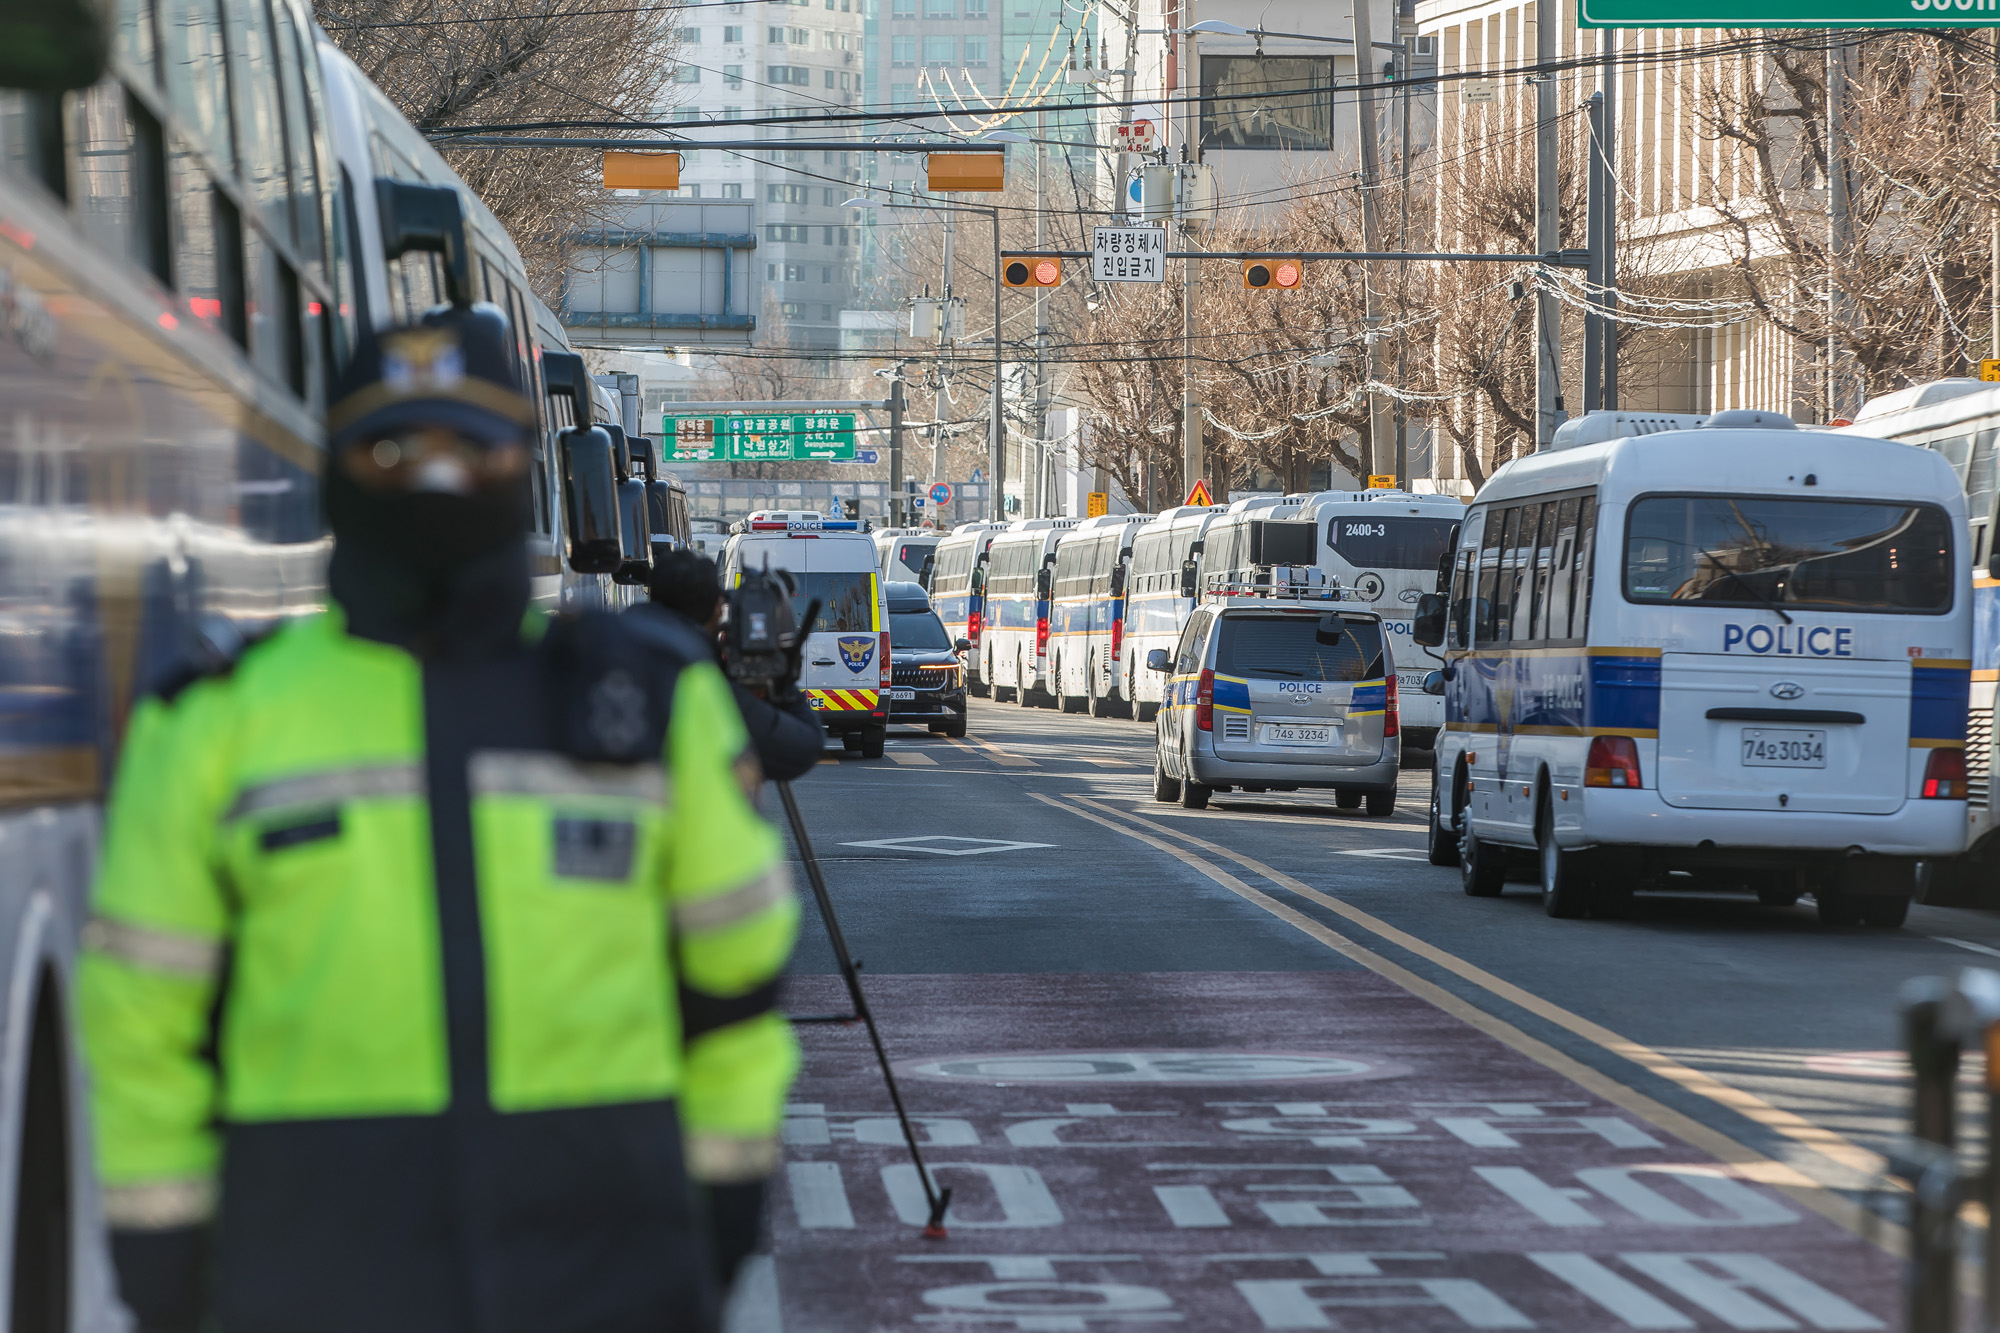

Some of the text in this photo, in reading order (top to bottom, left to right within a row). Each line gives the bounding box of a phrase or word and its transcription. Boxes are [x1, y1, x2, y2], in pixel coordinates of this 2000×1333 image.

[1118, 126, 1144, 137] 위험
[1096, 232, 1163, 254] 차량정체시
[1103, 257, 1155, 277] 진입금지
[677, 419, 705, 430] 창덕궁
[744, 419, 790, 430] 탑골공원
[804, 418, 840, 429] 광화문
[744, 439, 790, 451] 낙원상가
[788, 522, 821, 530] POLICE
[1345, 523, 1385, 537] 2400-3
[1385, 622, 1413, 635] POL
[1723, 623, 1853, 657] POLICE
[1279, 682, 1322, 693] POLICE
[808, 698, 824, 707] ICE
[1274, 729, 1324, 740] 74오 3234
[1743, 740, 1824, 761] 74오3034
